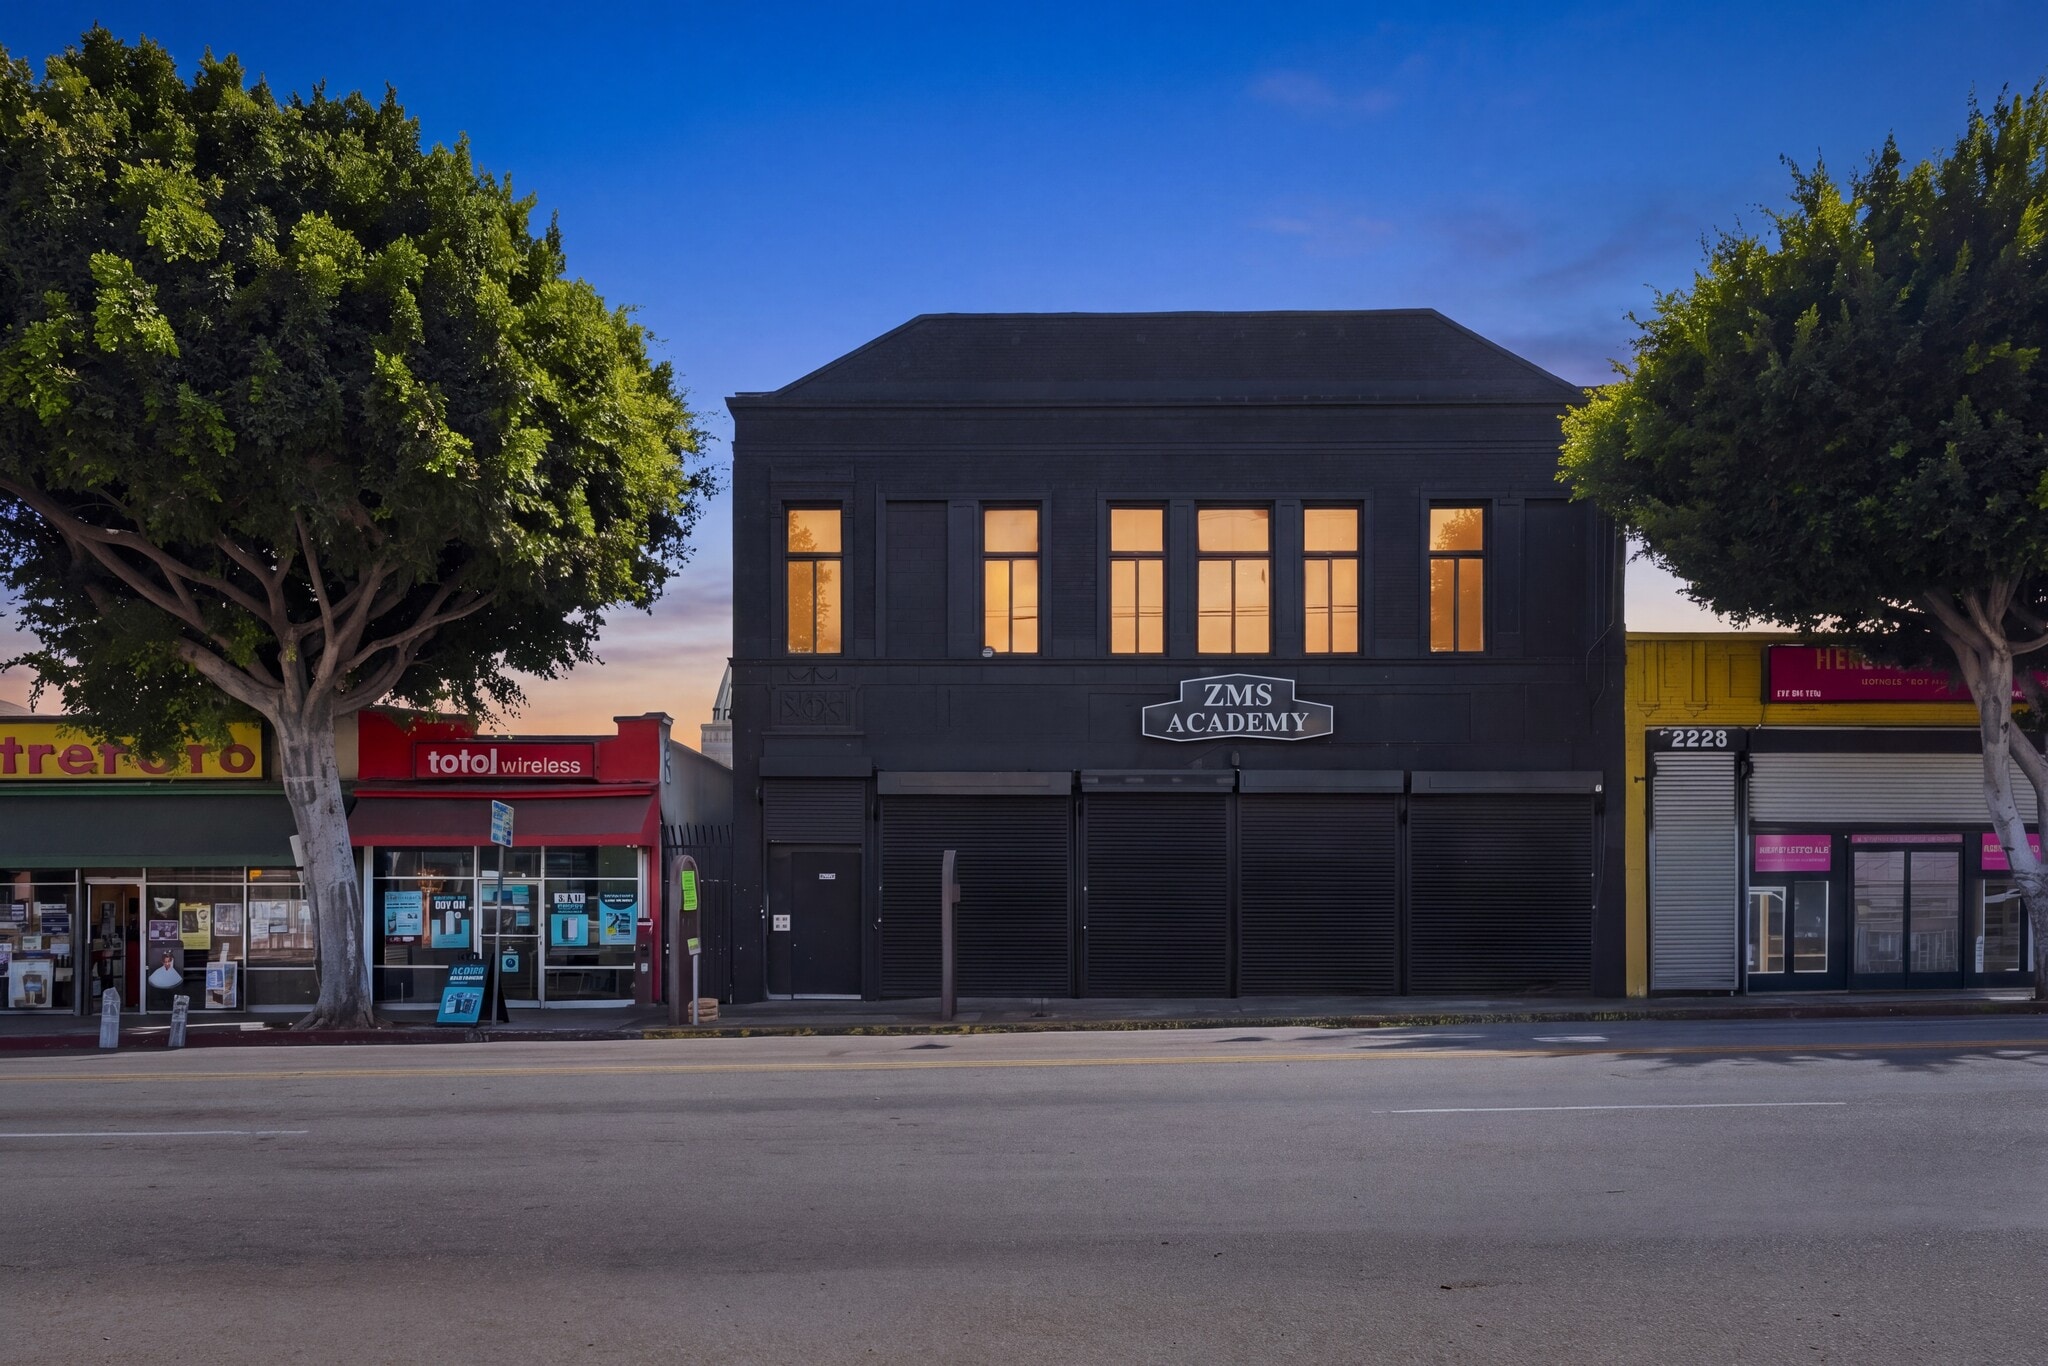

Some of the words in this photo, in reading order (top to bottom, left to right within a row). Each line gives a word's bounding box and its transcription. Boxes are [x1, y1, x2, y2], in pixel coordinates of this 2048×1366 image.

[1203, 683, 1273, 707] ZMS
[1165, 712, 1309, 733] ACADEMY
[1671, 729, 1728, 748] 2228
[501, 757, 581, 774] wireless
